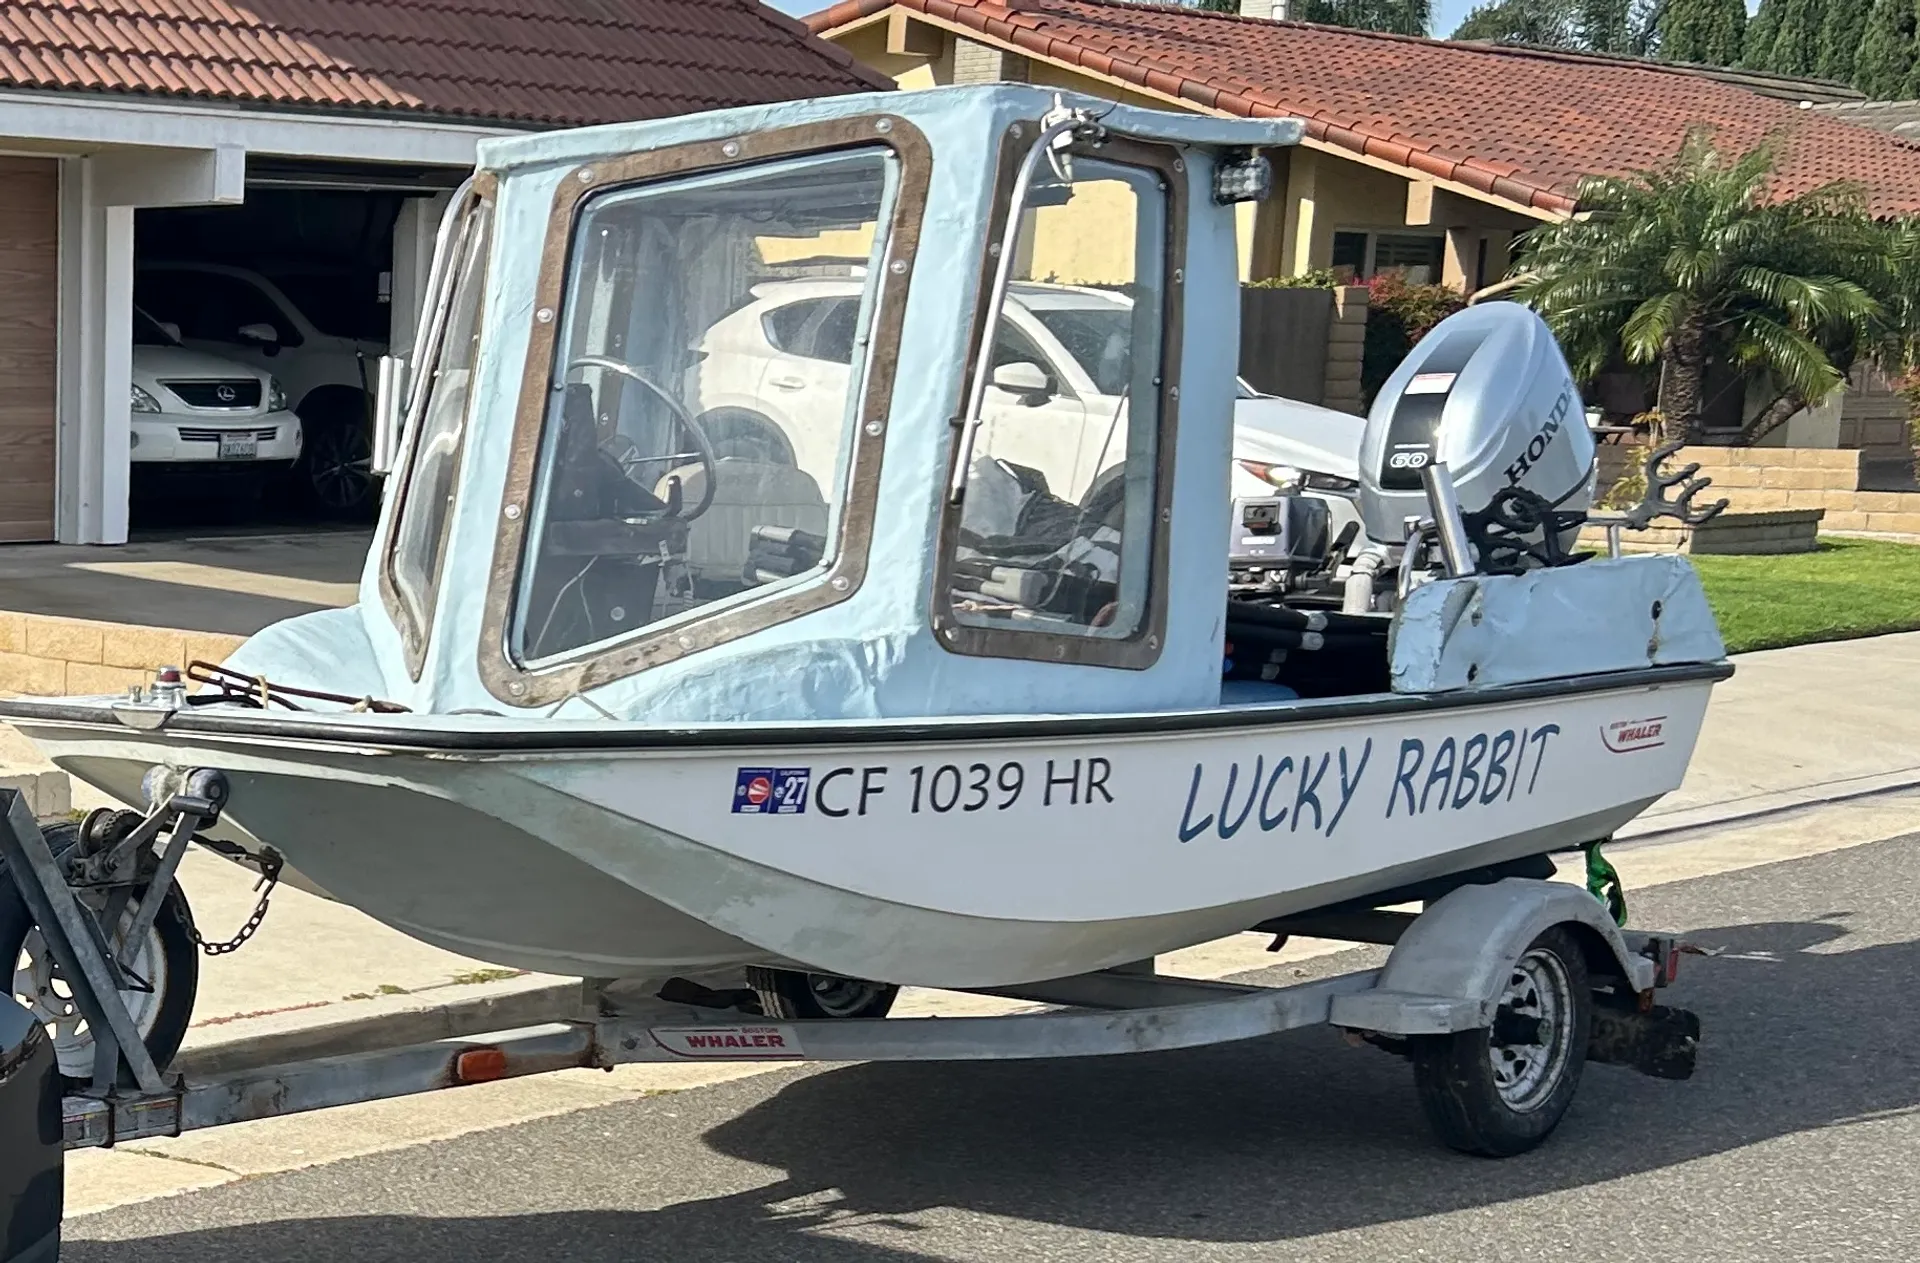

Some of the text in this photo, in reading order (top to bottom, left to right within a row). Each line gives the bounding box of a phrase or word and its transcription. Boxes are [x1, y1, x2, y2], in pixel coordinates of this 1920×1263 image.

[1390, 452, 1428, 468] 60
[1617, 723, 1662, 743] WHALER
[782, 776, 808, 805] 27
[814, 756, 1115, 818] CF 1039 HR
[1178, 723, 1560, 843] LUCKY RABBIT
[684, 1035, 785, 1048] WHALER
